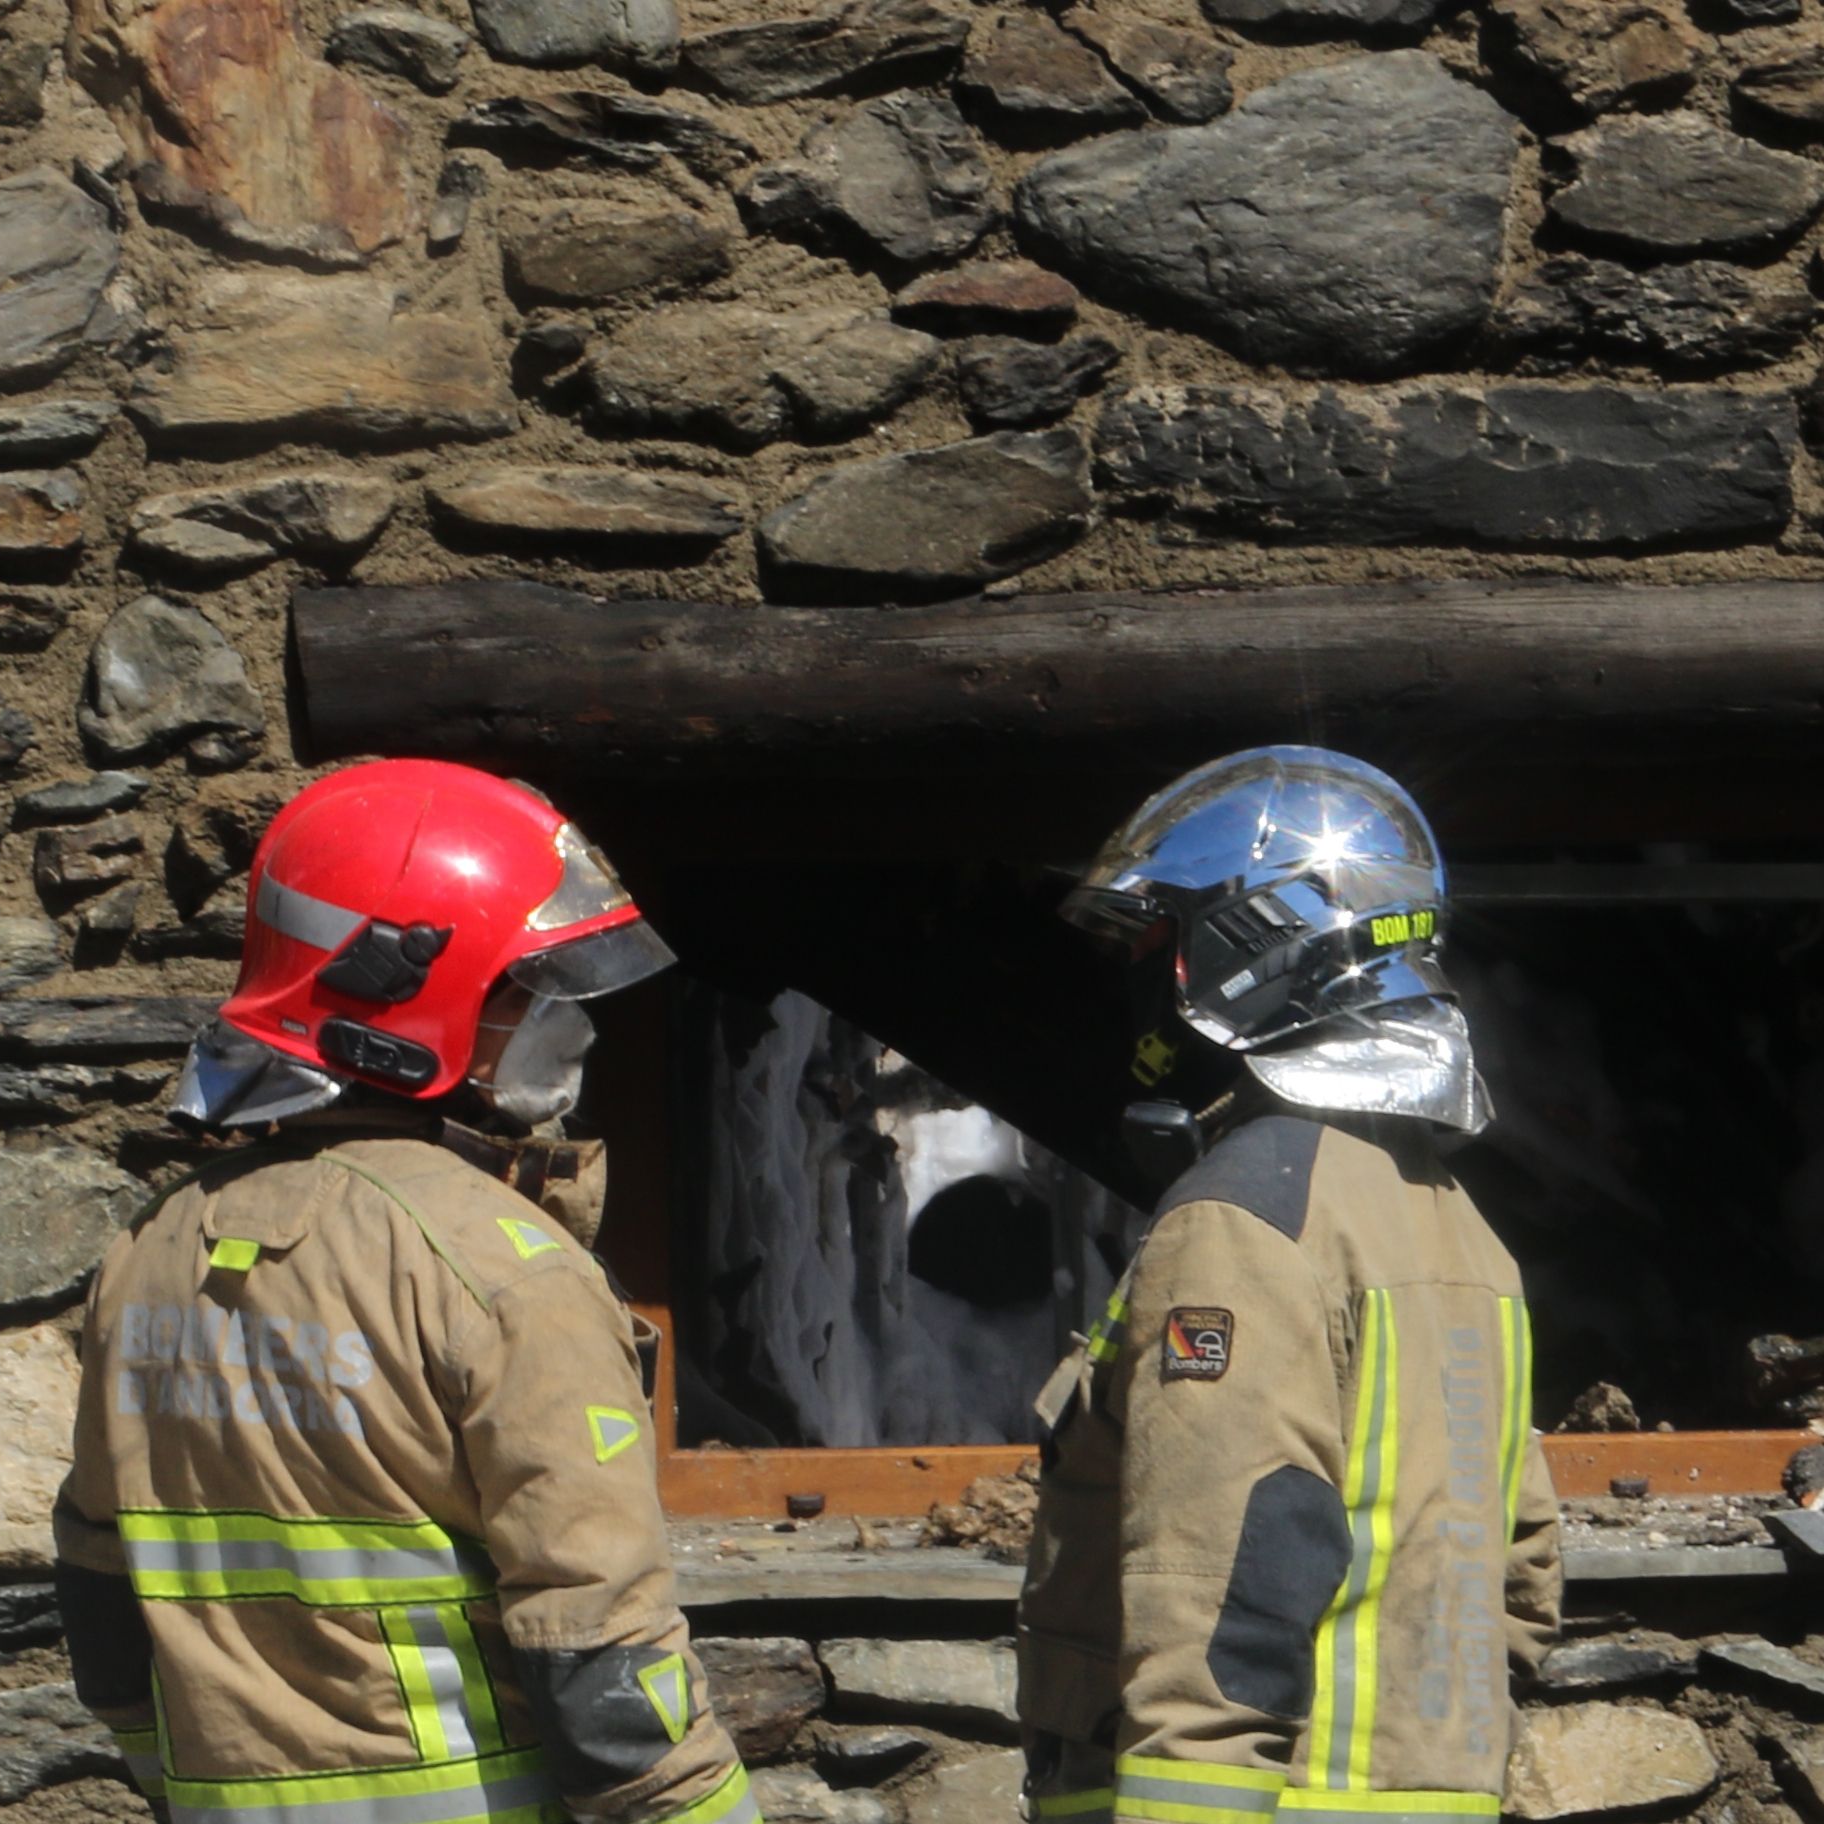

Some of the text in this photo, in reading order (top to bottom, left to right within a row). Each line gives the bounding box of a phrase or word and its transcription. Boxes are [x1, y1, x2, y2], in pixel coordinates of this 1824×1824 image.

[1370, 915, 1409, 946] BOM
[119, 1303, 374, 1388] BOMBERS
[117, 1370, 366, 1441] DANDORRA
